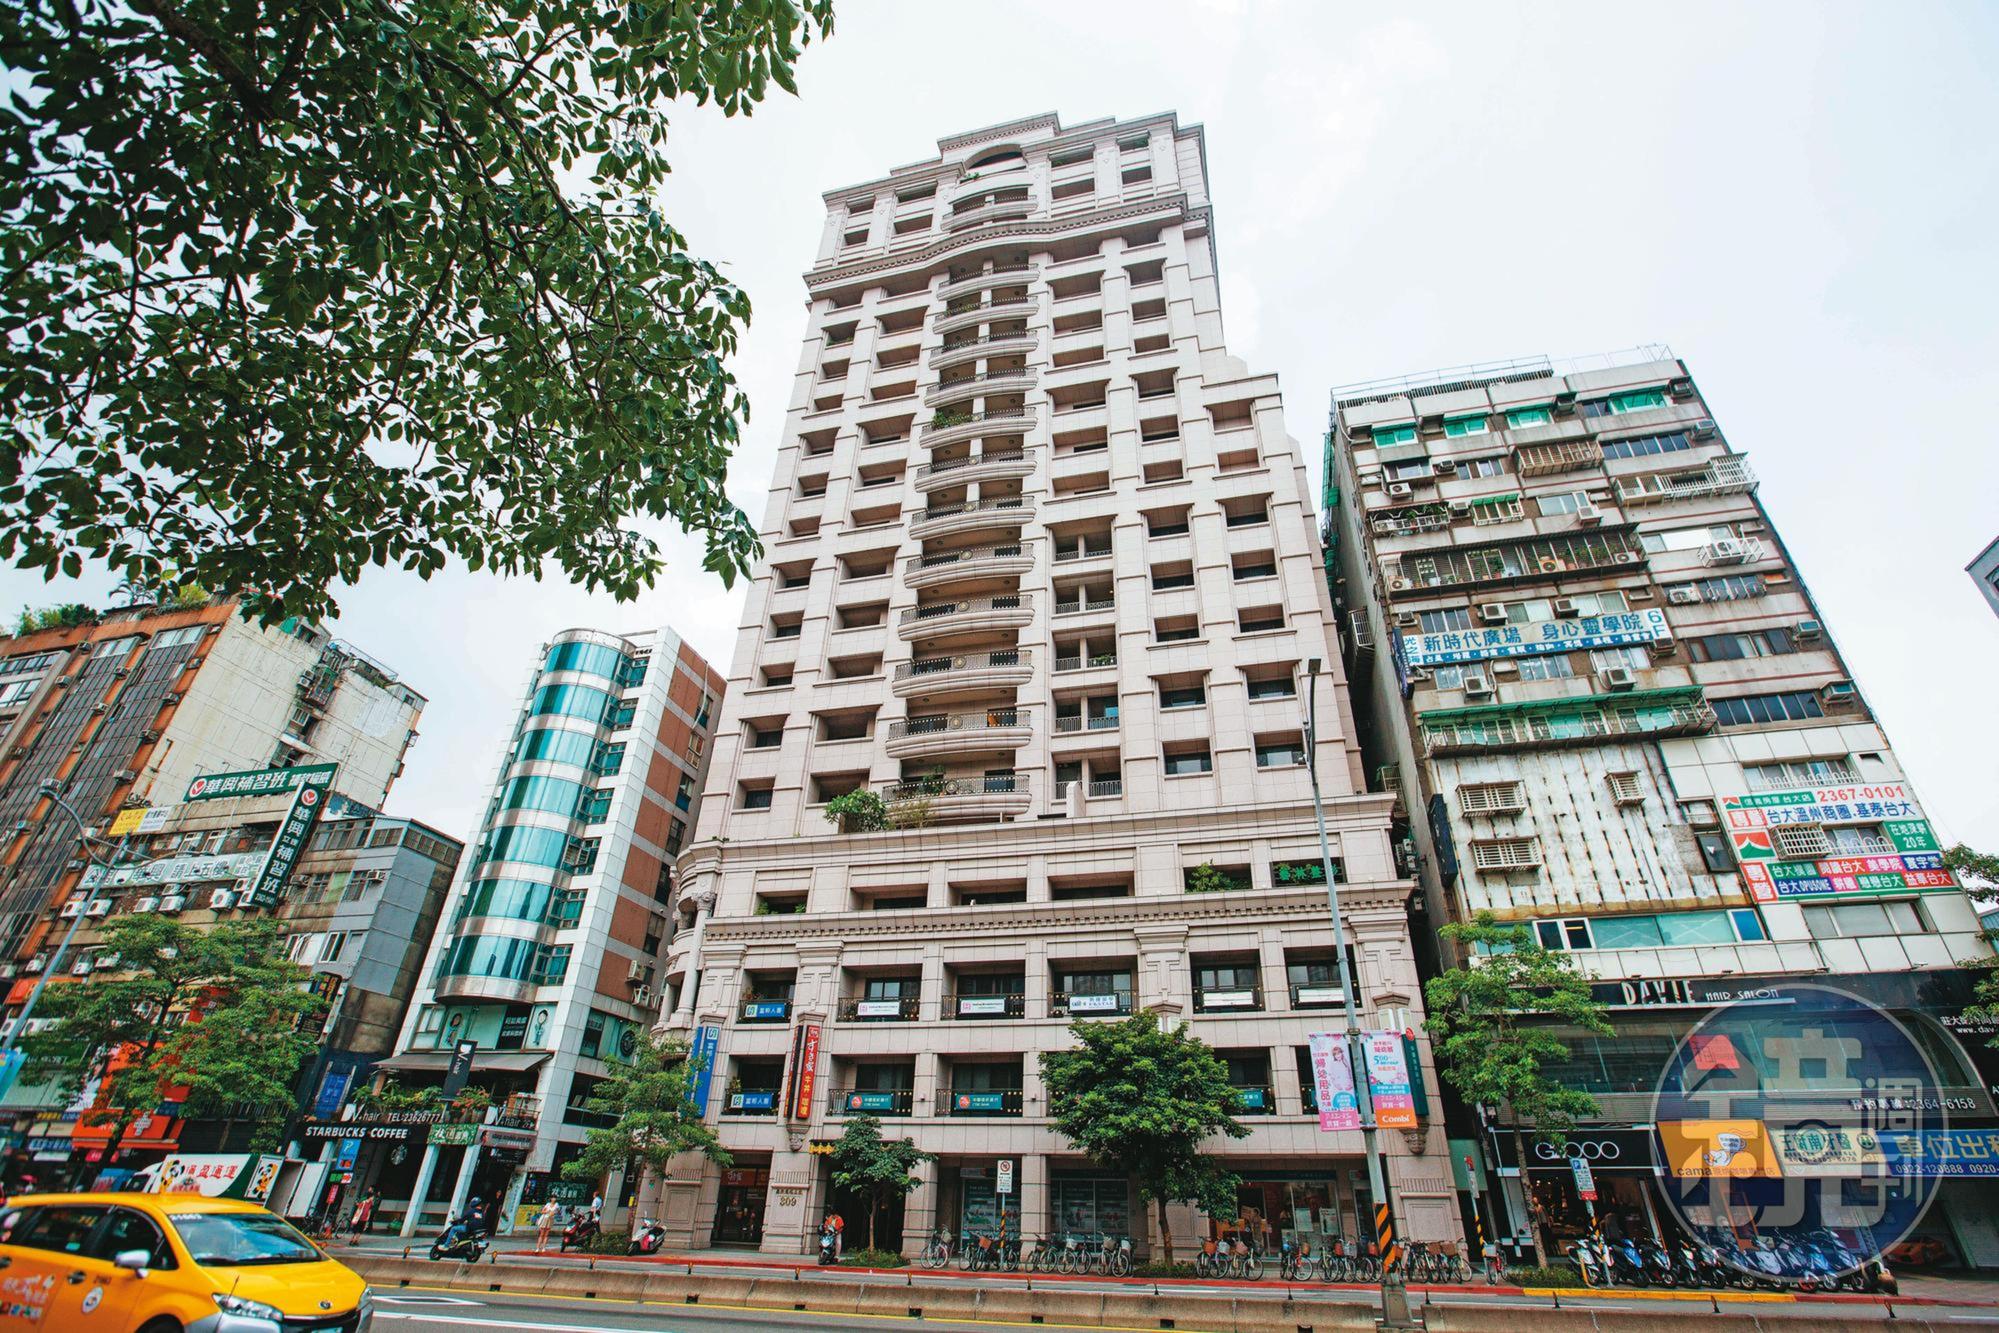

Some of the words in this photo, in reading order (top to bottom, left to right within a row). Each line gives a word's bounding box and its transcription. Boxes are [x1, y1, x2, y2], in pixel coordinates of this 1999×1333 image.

[1423, 626, 1521, 652] 新時代廣場
[1817, 785, 1905, 803] 2367-0101
[1382, 1115, 1410, 1123] Combi
[305, 1126, 367, 1138] STARBUCKS
[370, 1127, 408, 1139] COFFEE
